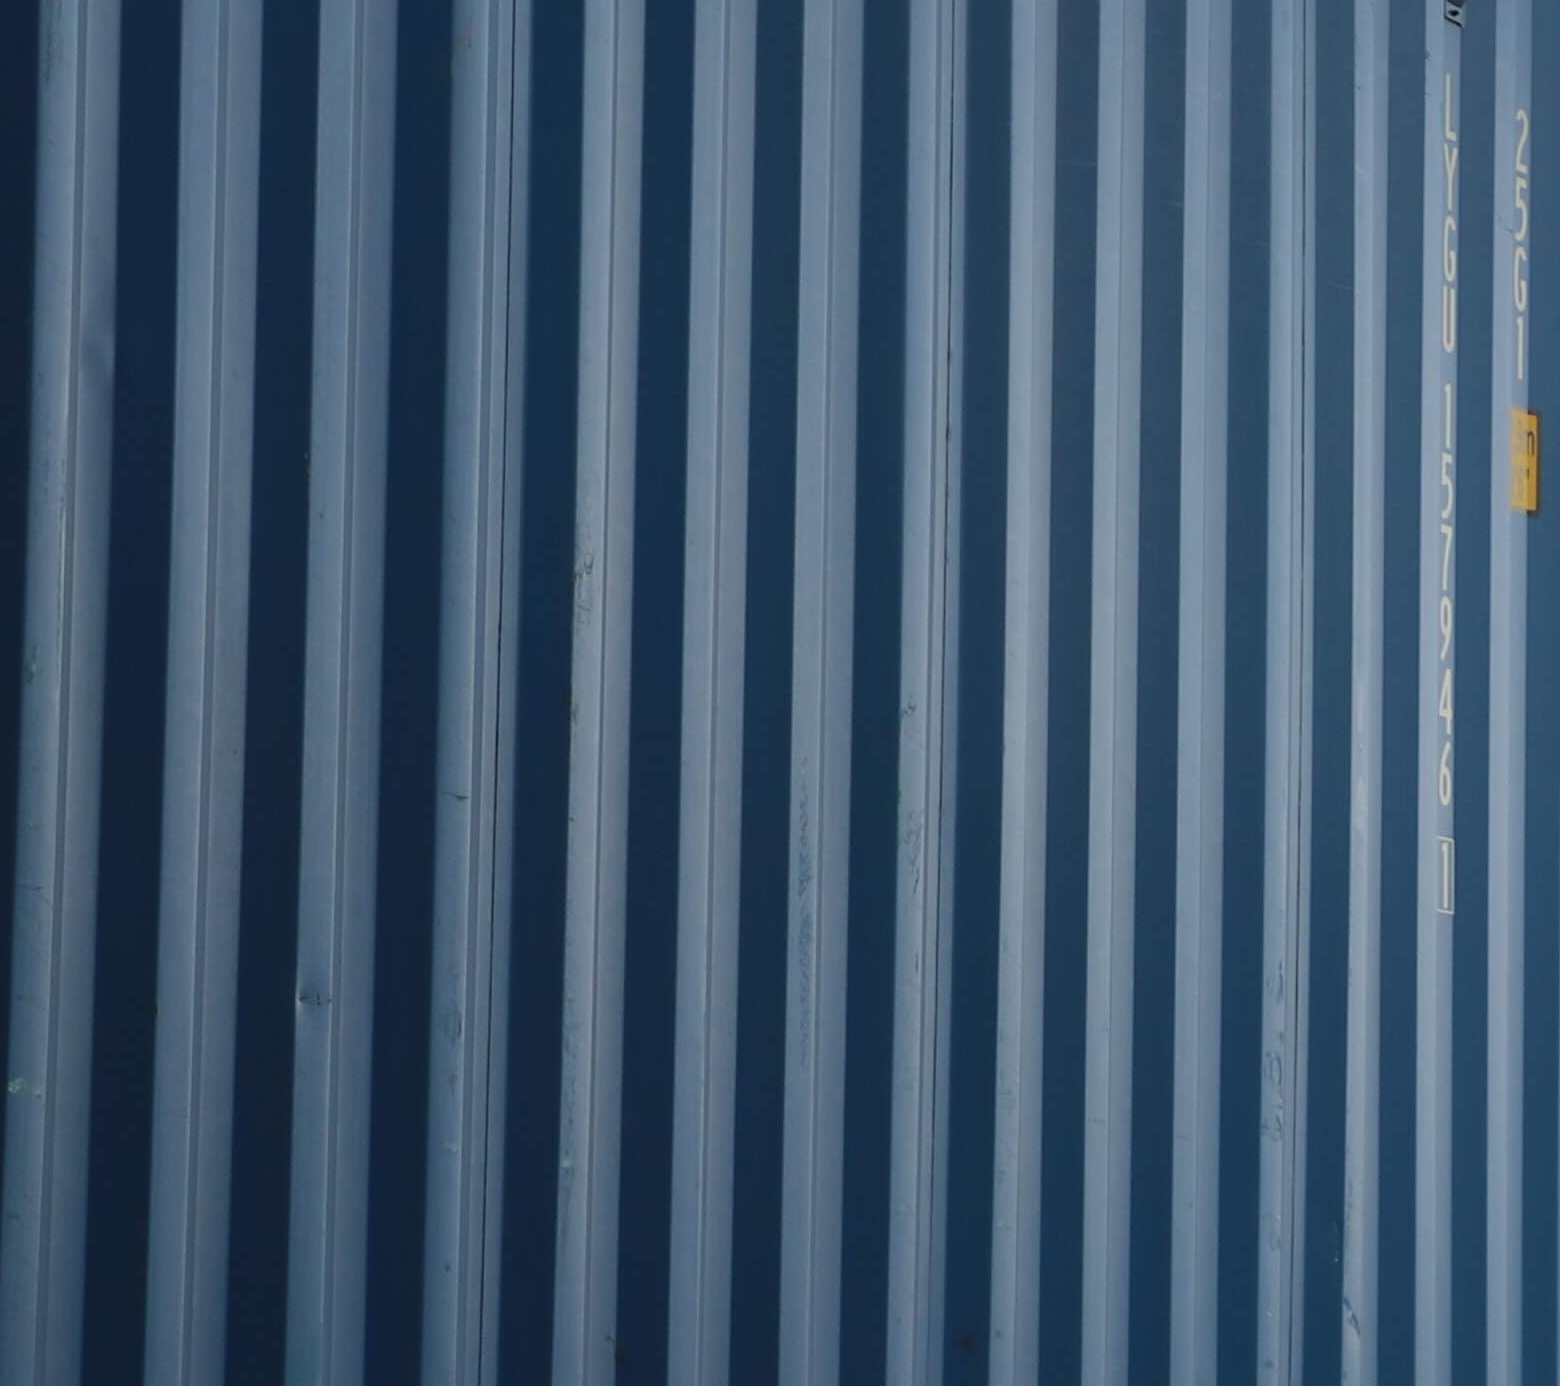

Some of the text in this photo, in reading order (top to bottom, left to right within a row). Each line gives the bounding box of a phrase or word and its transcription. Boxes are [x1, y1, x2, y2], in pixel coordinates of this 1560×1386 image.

[1442, 73, 1459, 352] LYGU
[1514, 109, 1530, 380] 25G1
[1438, 382, 1456, 805] 157946
